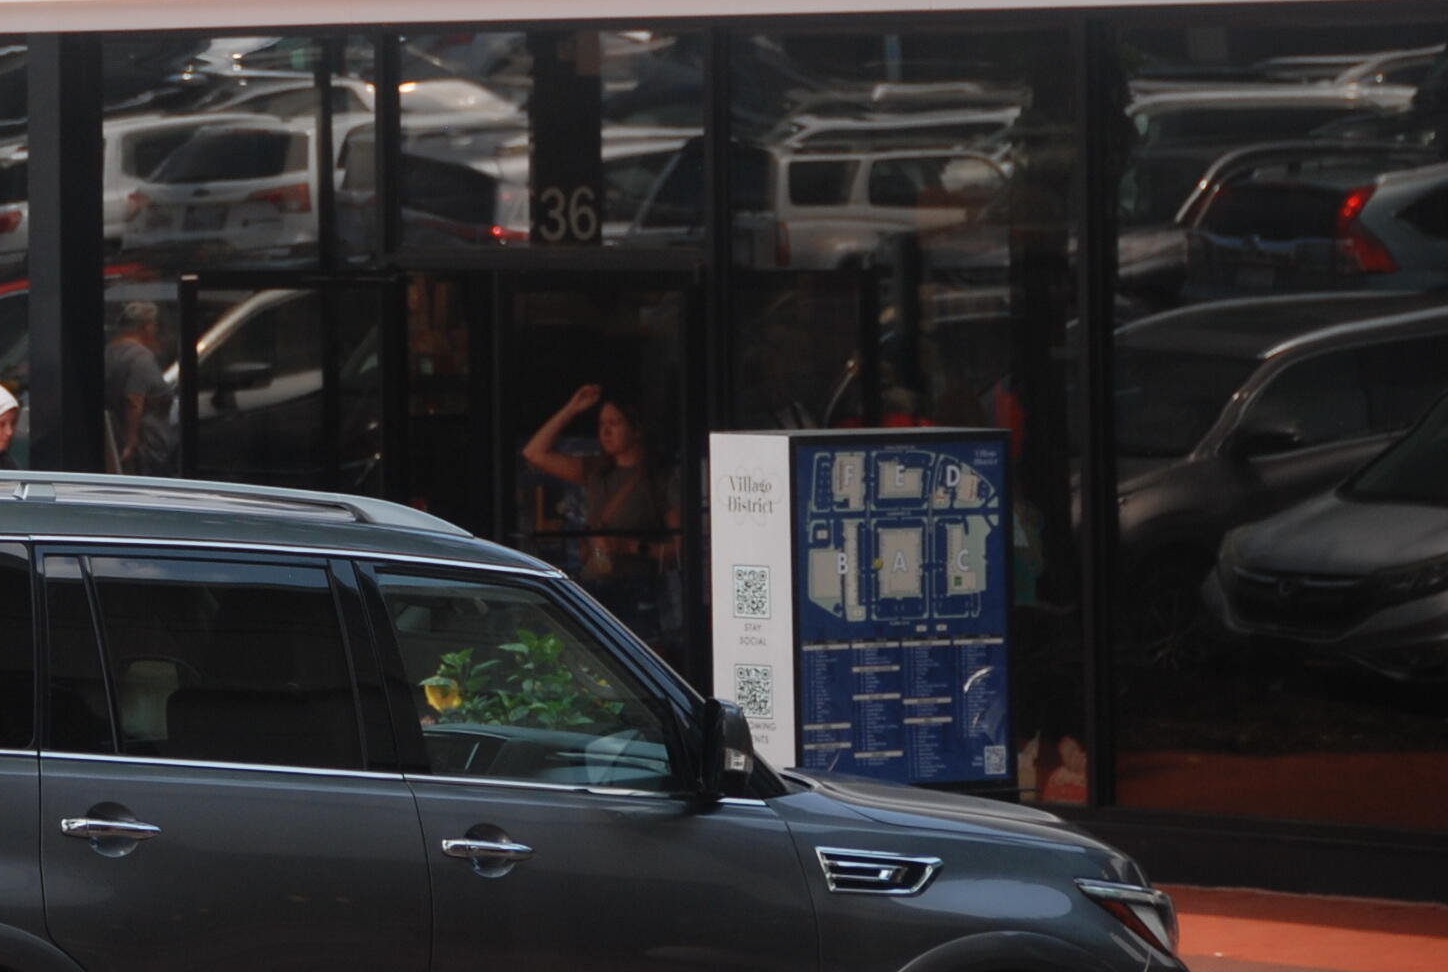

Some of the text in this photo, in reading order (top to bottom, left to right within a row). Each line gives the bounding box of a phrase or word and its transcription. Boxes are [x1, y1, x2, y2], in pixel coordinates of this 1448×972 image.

[540, 186, 597, 241] 36
[895, 465, 905, 486] E
[946, 465, 960, 487] D
[728, 495, 773, 514] District
[837, 549, 969, 575] B A C
